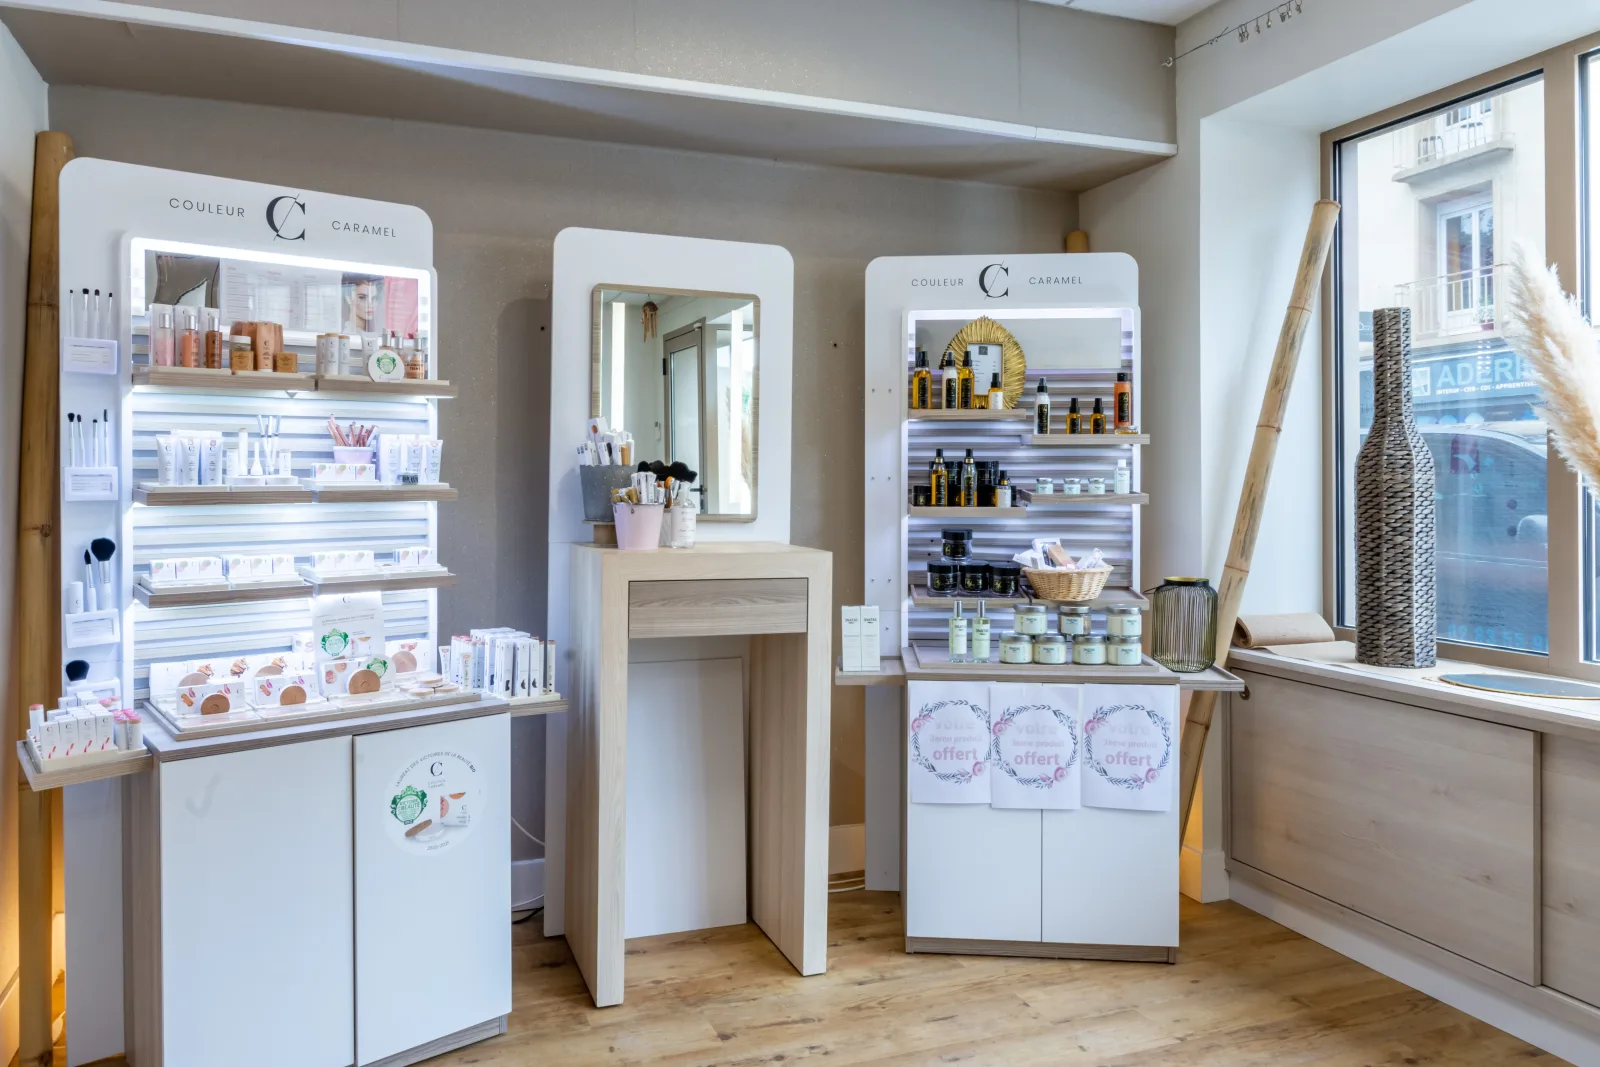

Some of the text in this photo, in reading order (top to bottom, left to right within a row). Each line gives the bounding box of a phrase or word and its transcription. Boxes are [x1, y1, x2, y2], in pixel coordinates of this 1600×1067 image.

[169, 198, 245, 218] COULEUR
[332, 220, 396, 238] CARAMEL
[911, 278, 964, 287] COULEUR
[1029, 276, 1082, 285] CARAMEL
[1437, 354, 1526, 387] ADERI
[933, 746, 978, 760] offert
[1014, 751, 1060, 766] offert
[1105, 751, 1152, 767] offert
